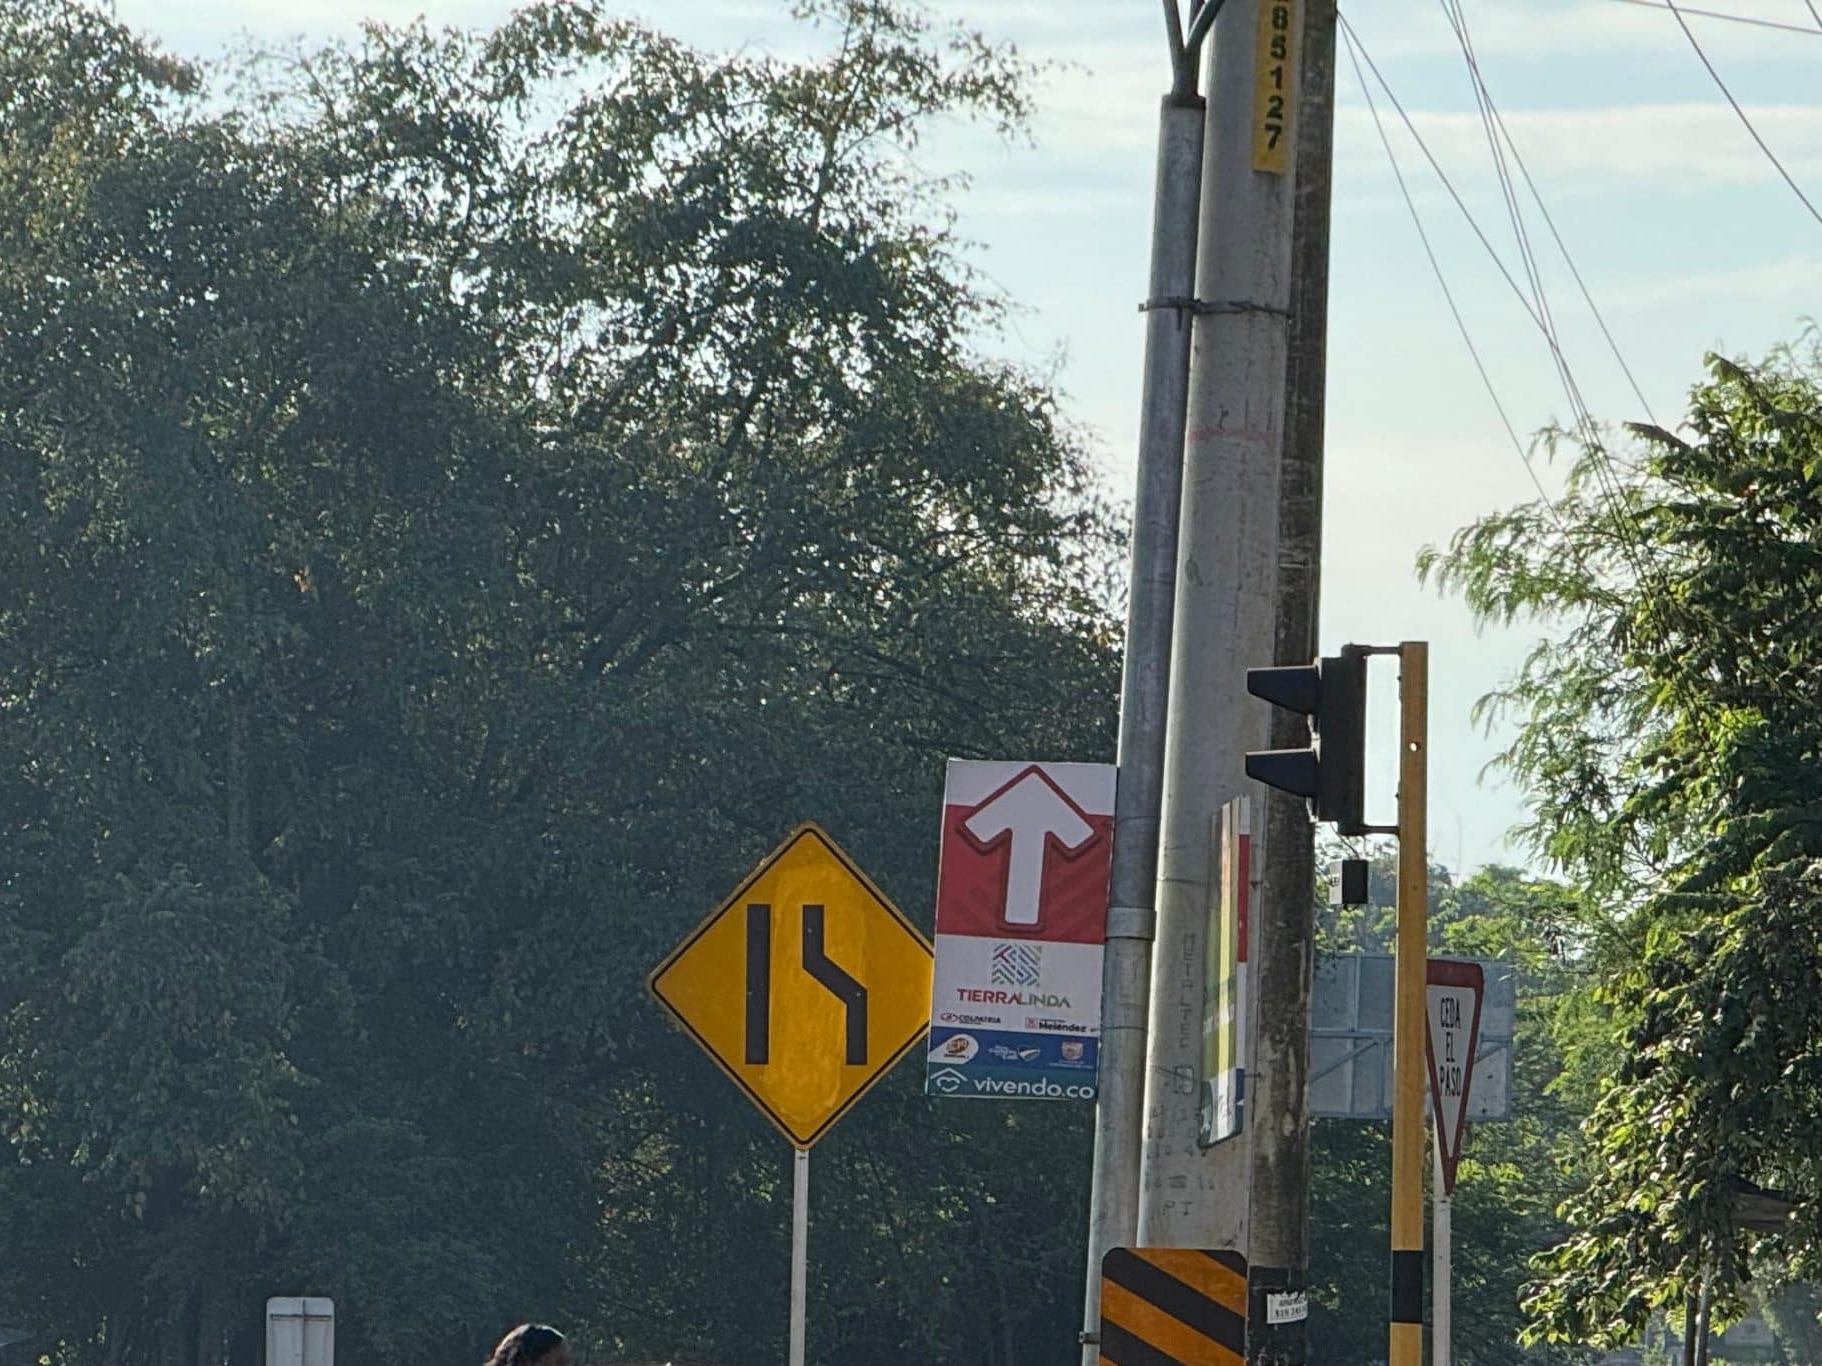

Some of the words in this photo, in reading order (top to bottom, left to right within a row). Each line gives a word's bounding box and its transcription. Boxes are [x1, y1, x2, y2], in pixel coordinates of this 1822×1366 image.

[1264, 0, 1289, 150] 85127
[1440, 997, 1461, 1030] CEDA
[1445, 1031, 1456, 1063] EL
[973, 1077, 1096, 1100] vivendo.co
[1439, 1065, 1462, 1097] PASO
